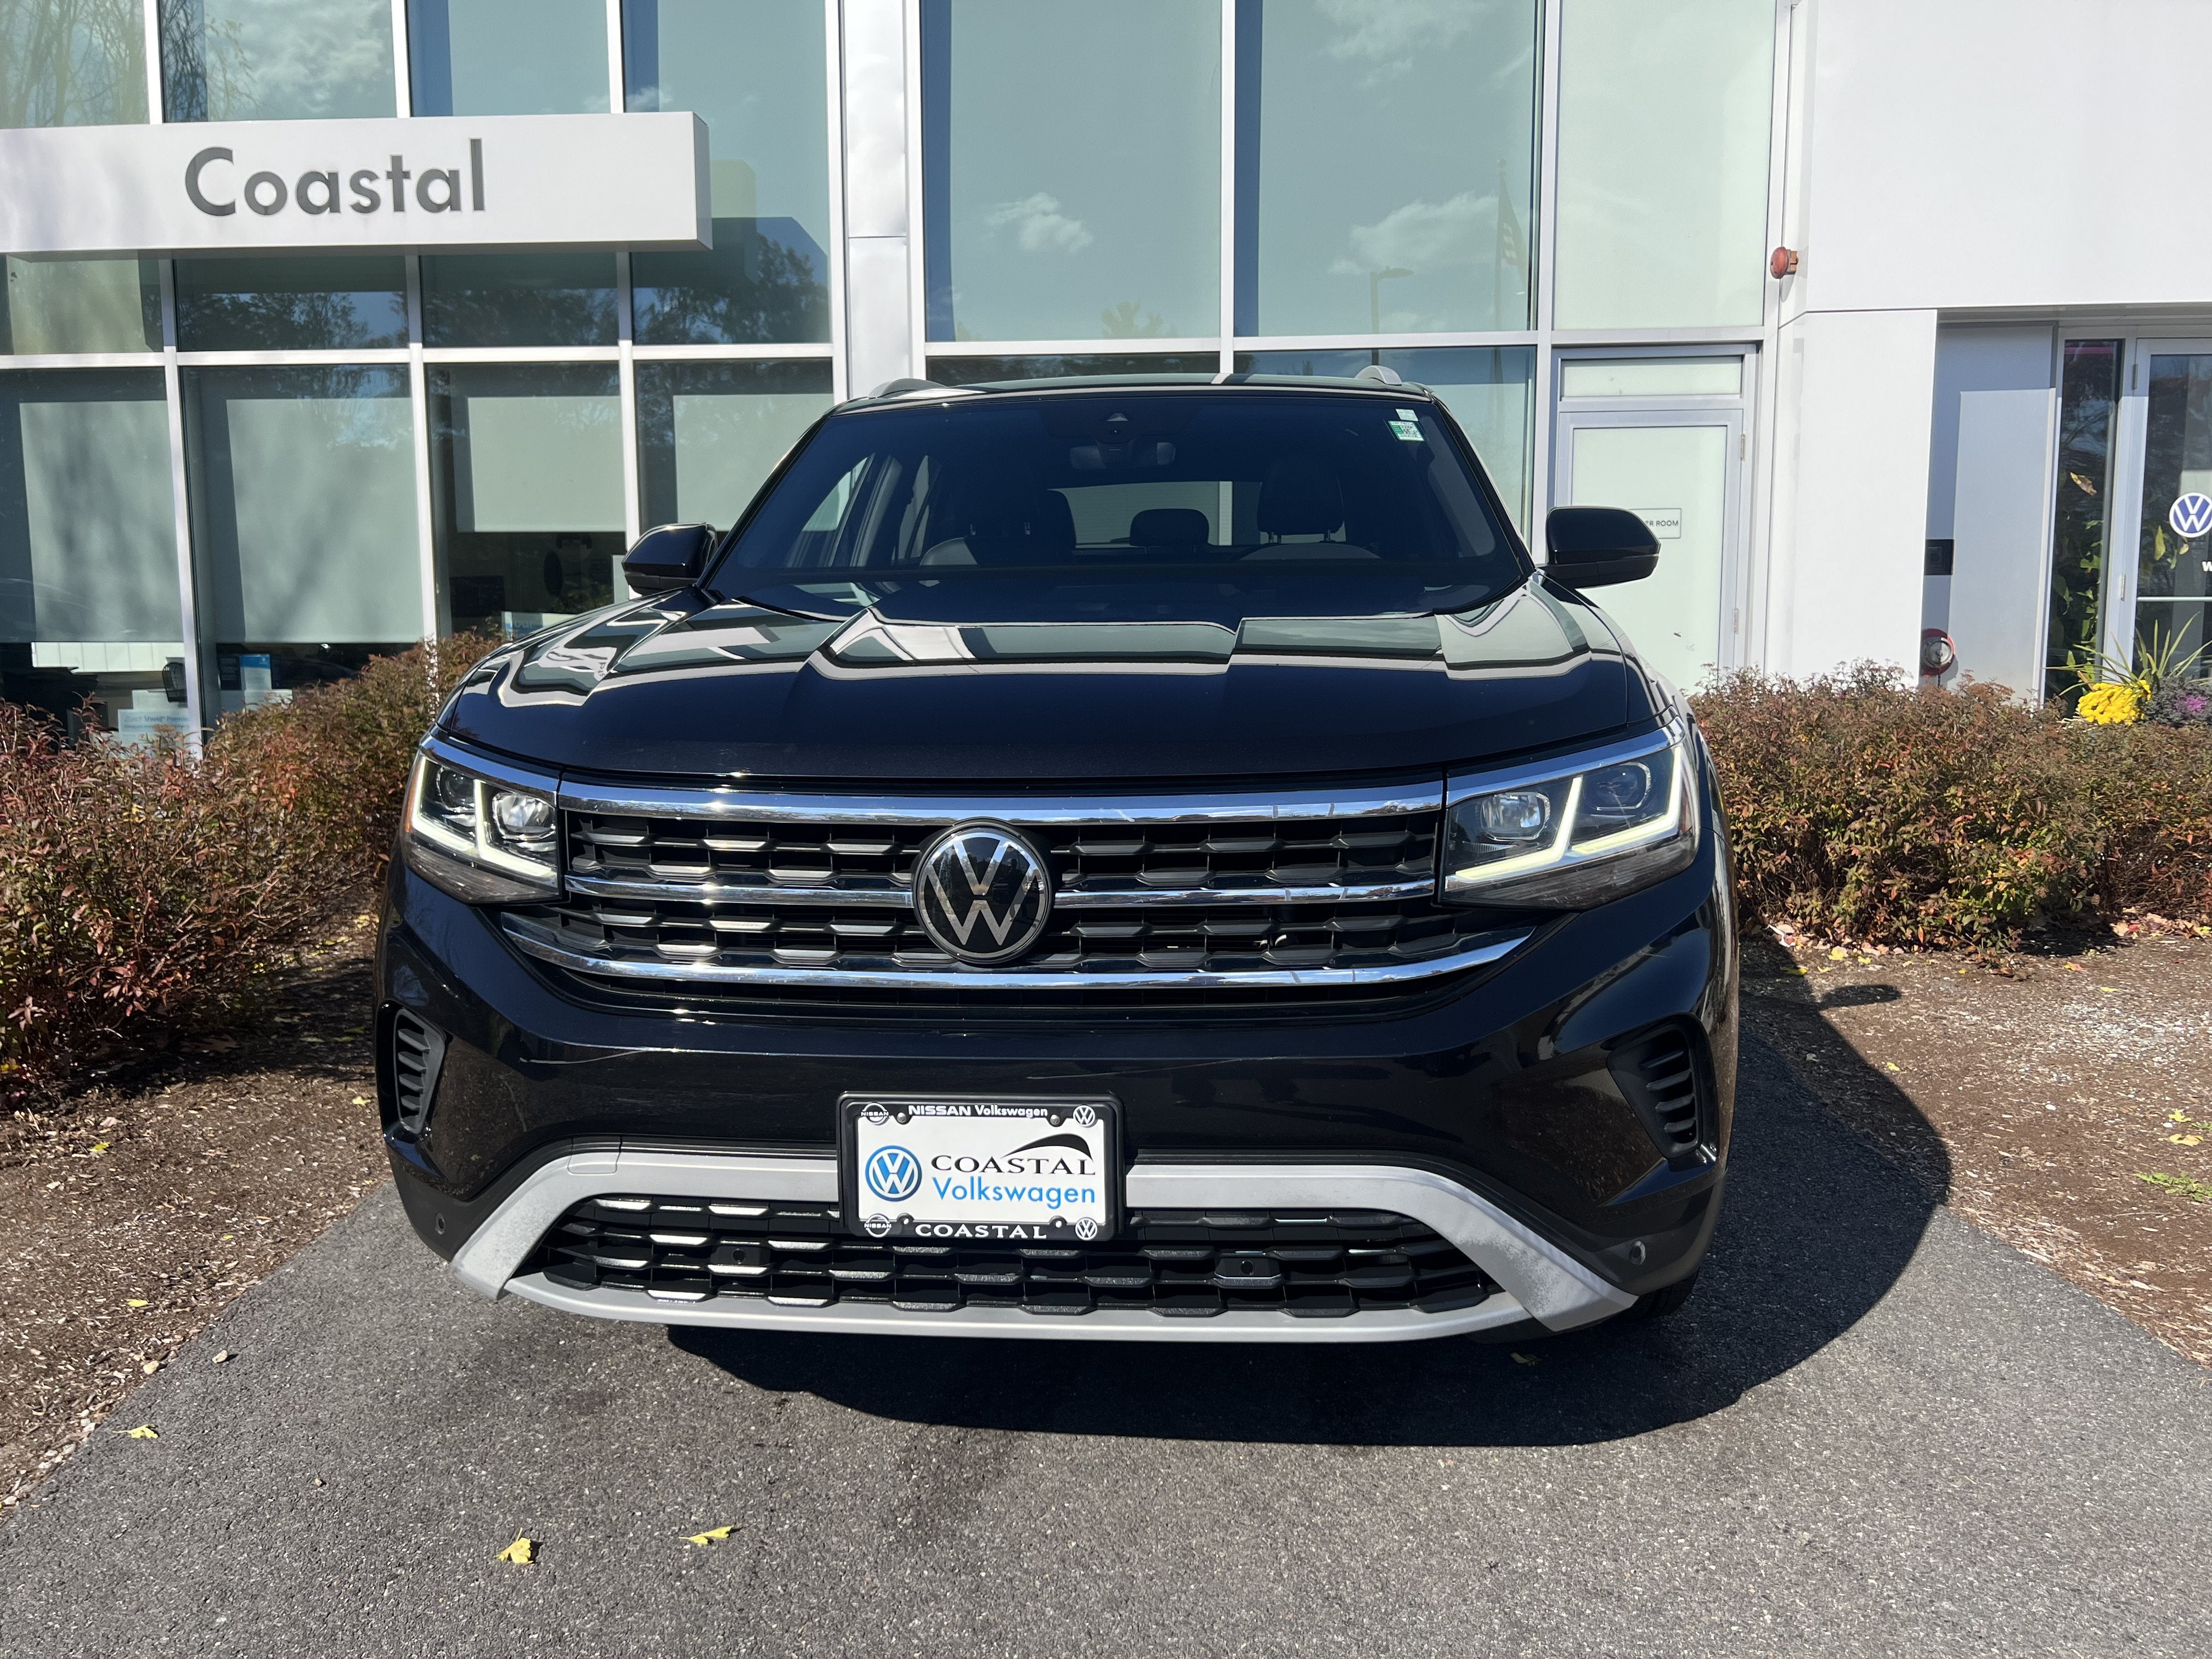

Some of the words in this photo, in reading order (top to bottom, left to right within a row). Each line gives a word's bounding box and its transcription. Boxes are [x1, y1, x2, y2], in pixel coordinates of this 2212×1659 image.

[184, 138, 486, 217] Coastal
[909, 1105, 970, 1116] NISSAN
[975, 1104, 1048, 1119] Volkswagen
[931, 1155, 1096, 1175] COASTAL
[933, 1176, 1095, 1209] Volkswagen
[915, 1223, 1047, 1239] COASTAL
